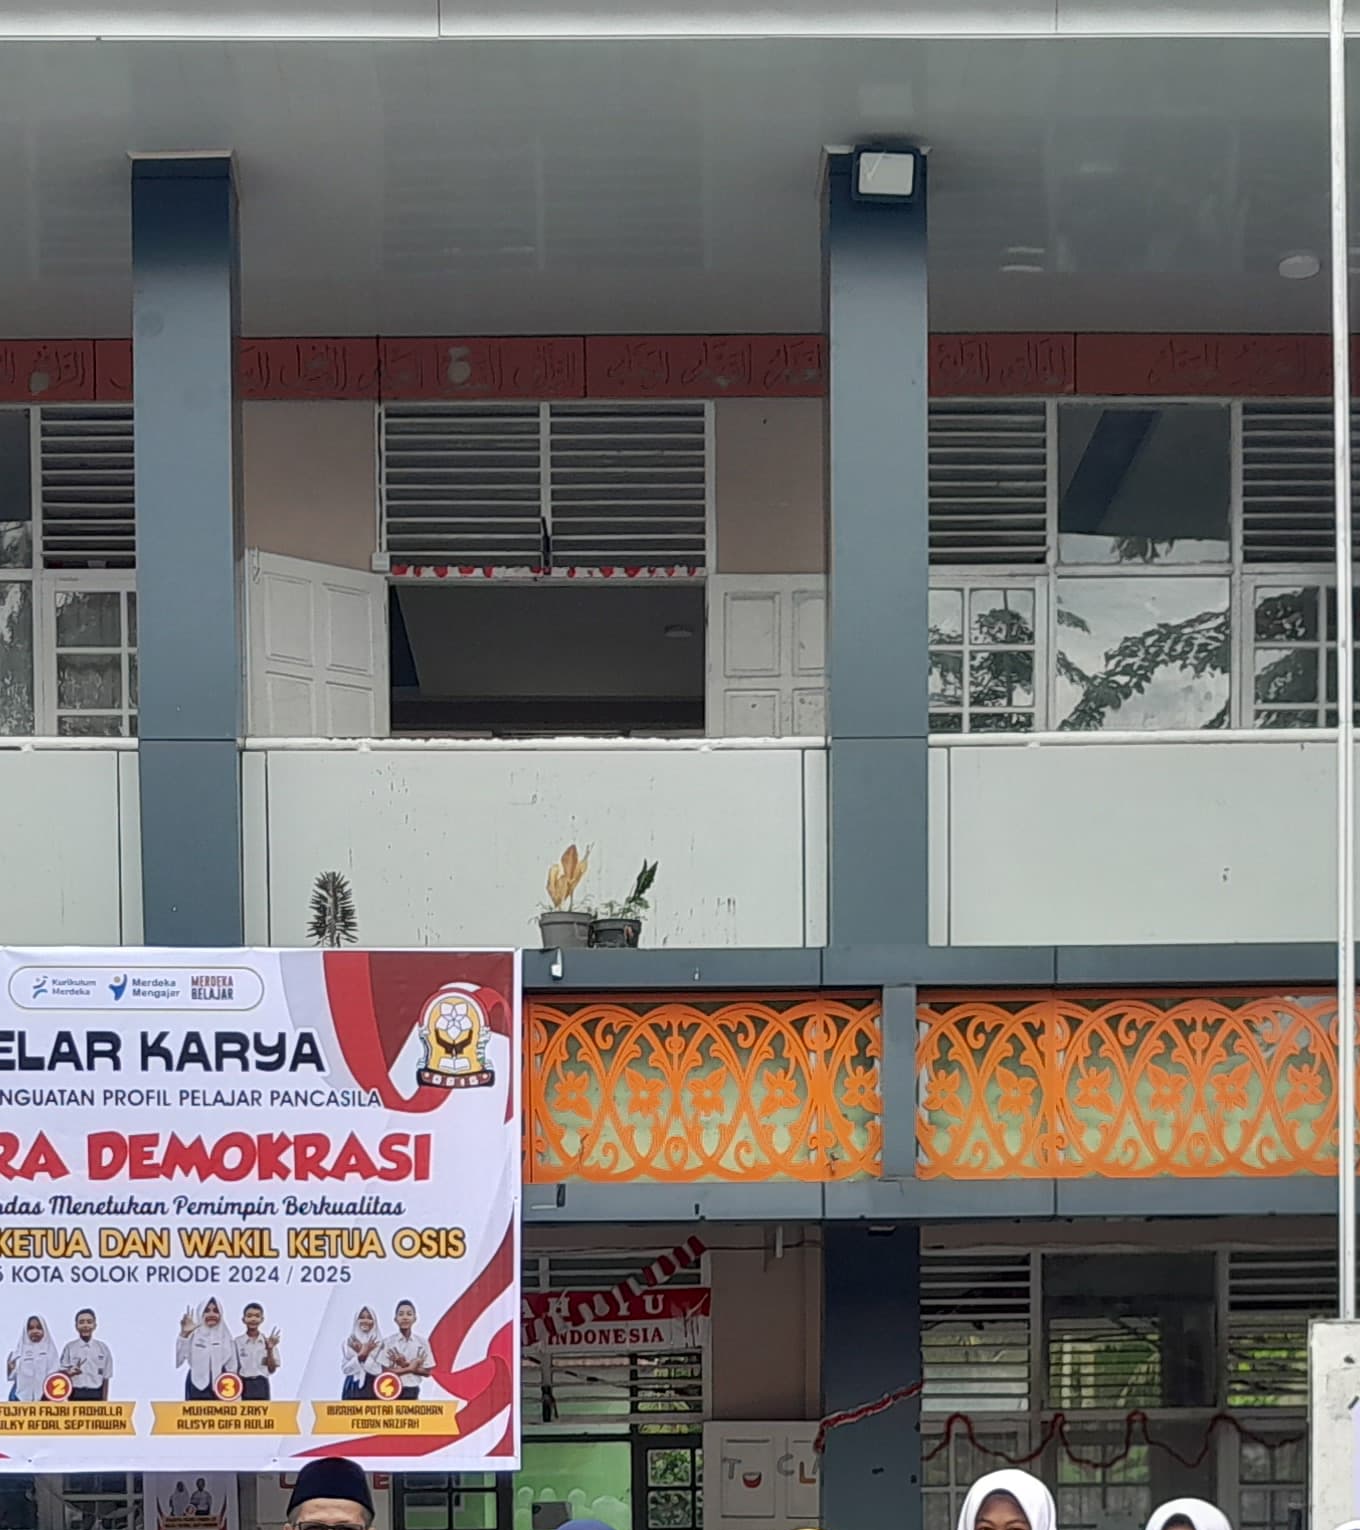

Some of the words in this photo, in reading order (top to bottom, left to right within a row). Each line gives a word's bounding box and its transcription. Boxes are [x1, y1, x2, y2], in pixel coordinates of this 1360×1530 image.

[51, 978, 97, 987] Kurikulum
[131, 978, 177, 988] Merdeka
[191, 975, 234, 987] MERDEKA
[51, 987, 91, 996] Merdeka
[131, 988, 181, 999] Mengajar
[191, 987, 234, 1000] BELAJAR
[141, 1032, 325, 1072] KARYA
[104, 1090, 170, 1106] PROFIL
[180, 1090, 261, 1106] PELAJAR
[271, 1089, 381, 1108] PANCASILA
[87, 1131, 430, 1182] DEMOKRASI
[49, 1196, 168, 1215] Menetukan
[173, 1196, 278, 1221] Pemimpin
[283, 1196, 405, 1215] Berkualitas
[99, 1228, 170, 1258] DAN
[178, 1228, 279, 1258] WAKIL
[288, 1228, 386, 1259] KETUA
[392, 1227, 466, 1259] OSIS
[12, 1266, 64, 1283] KOTA
[71, 1266, 138, 1282] SOLOK
[147, 1266, 219, 1282] PRIODE
[229, 1266, 279, 1282] 2024
[301, 1266, 351, 1282] 2025
[51, 1379, 67, 1396] 2
[220, 1379, 236, 1397] 3
[380, 1379, 395, 1397] 4
[239, 1405, 269, 1417] ZAKY
[63, 1419, 127, 1431] SEPTIAWAN
